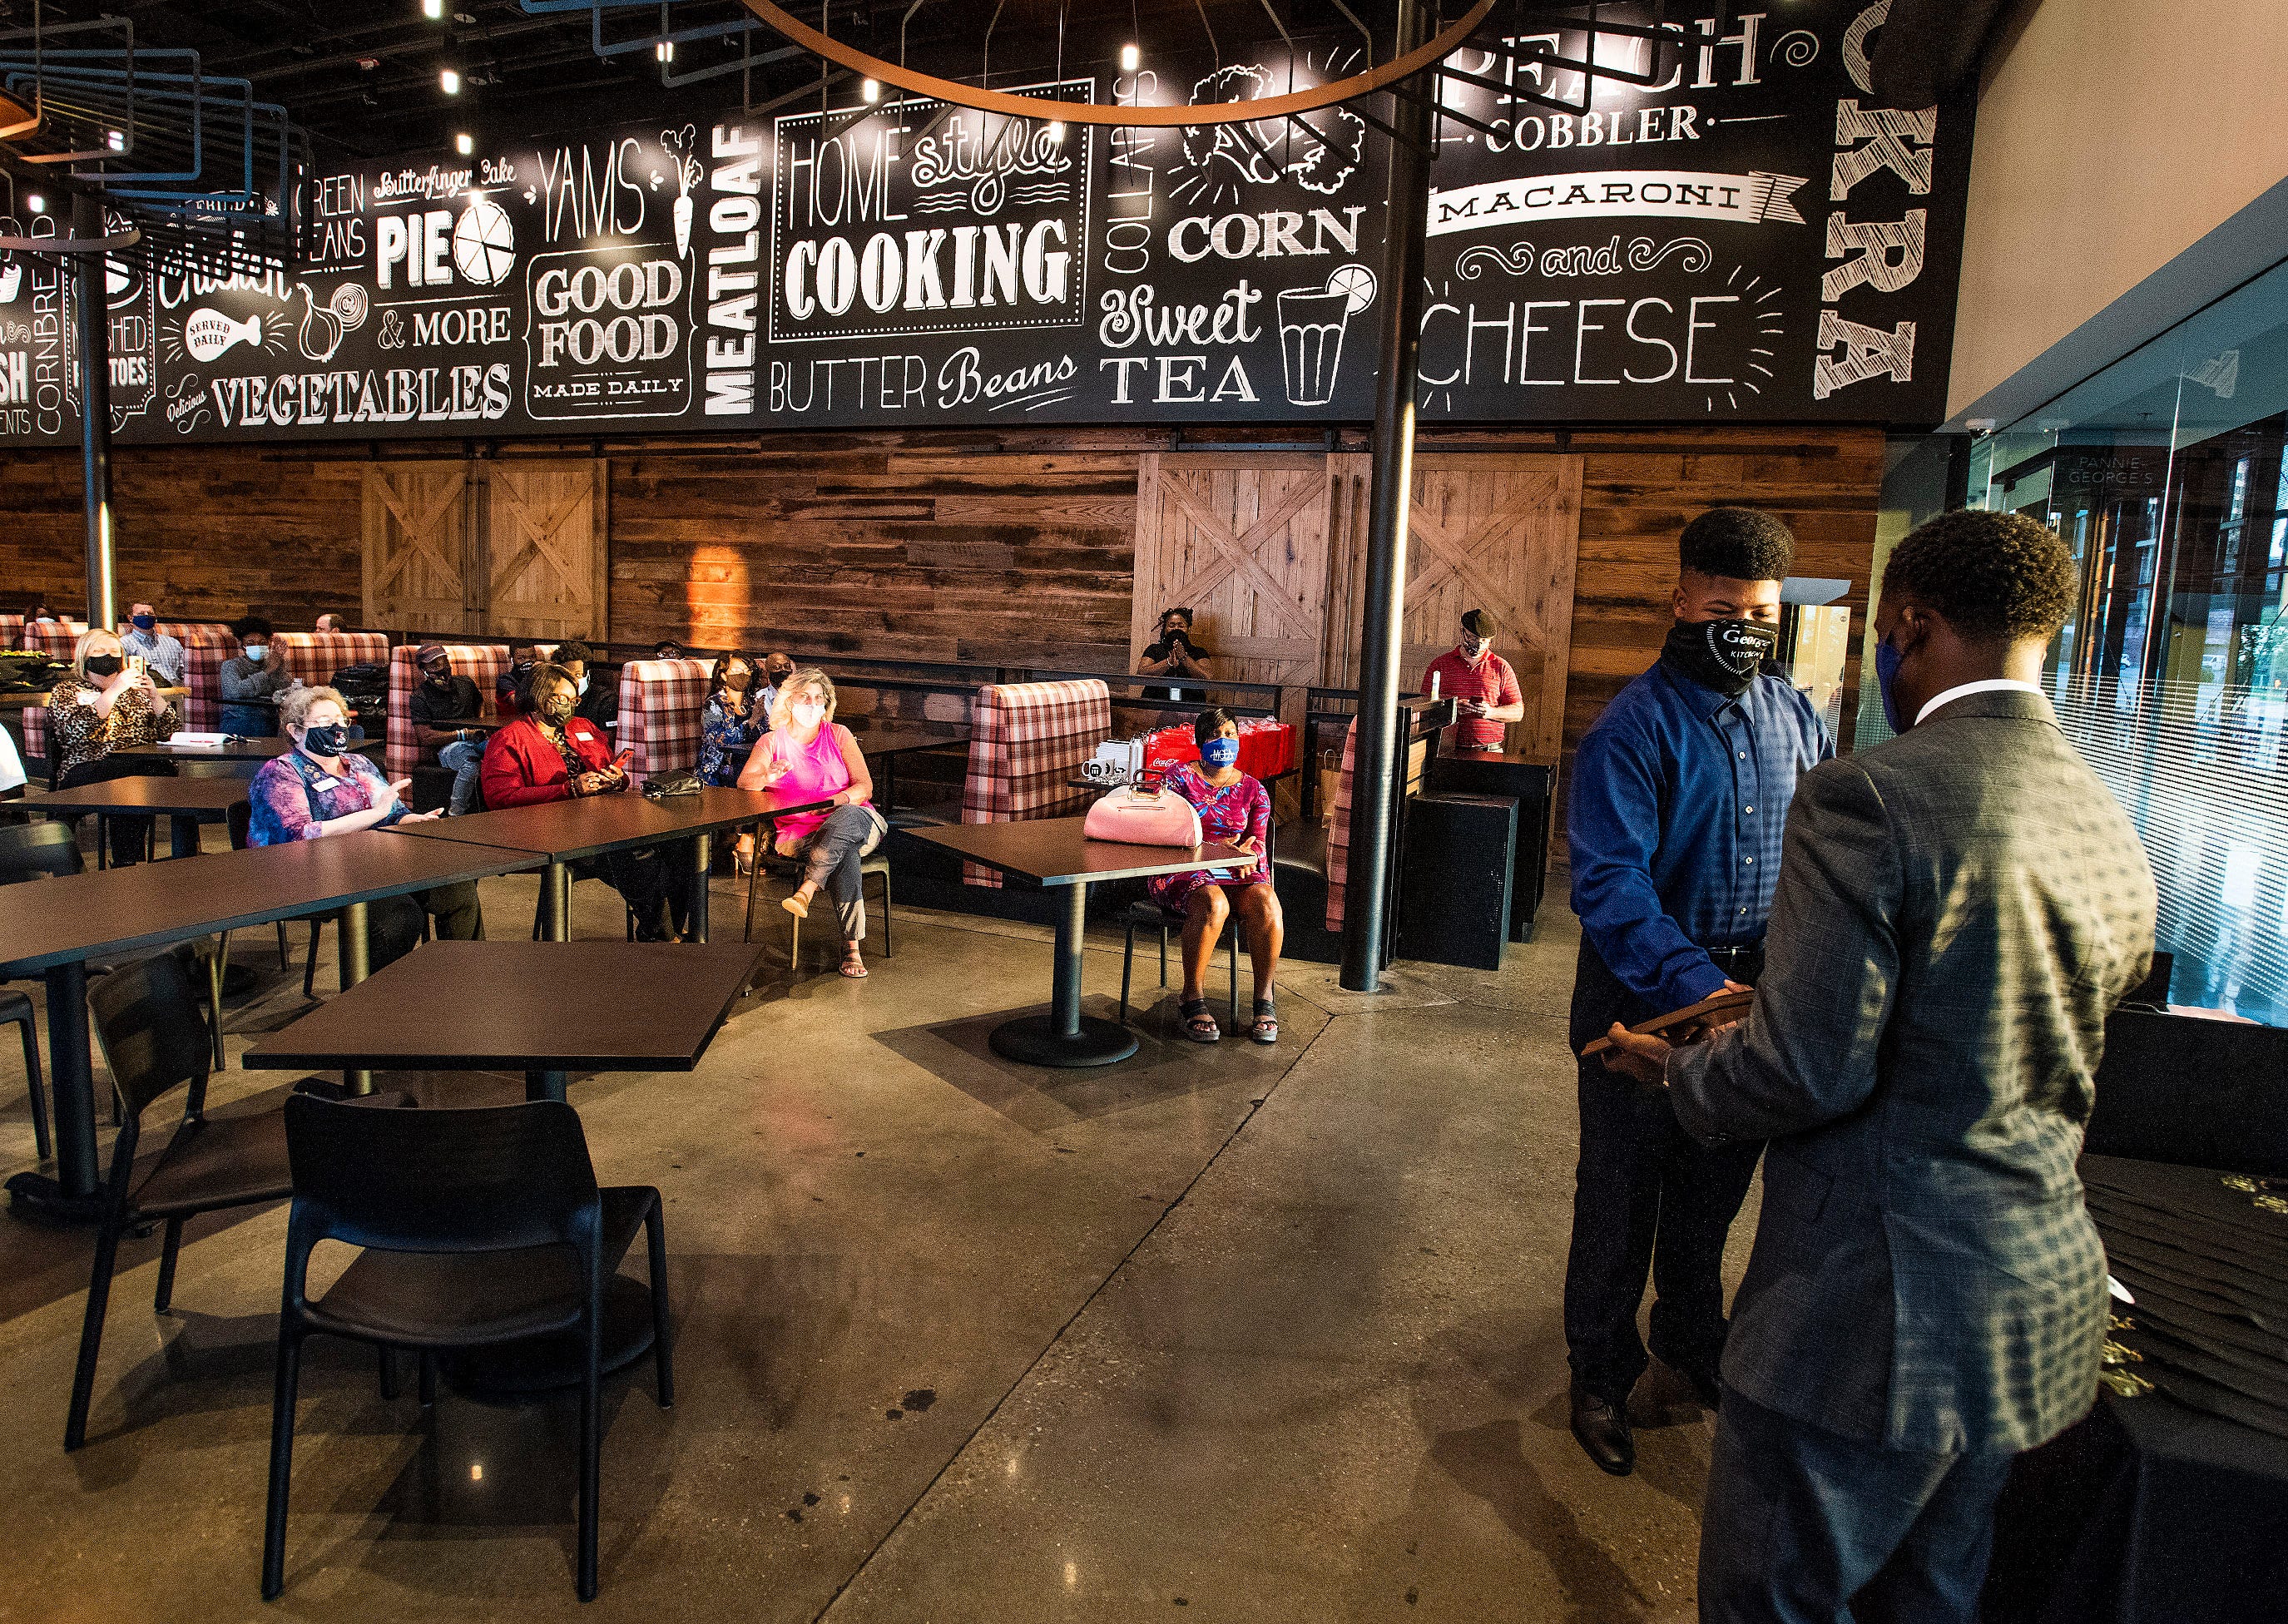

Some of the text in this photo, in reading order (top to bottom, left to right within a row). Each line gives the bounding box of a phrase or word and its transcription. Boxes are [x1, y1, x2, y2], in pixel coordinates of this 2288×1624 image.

[1440, 12, 1766, 108] PEACH
[1485, 104, 1701, 153] COBBLER
[374, 156, 518, 201] Butterfinger Cake
[537, 137, 645, 243] YAMS
[789, 115, 1072, 230] HOME style
[1438, 182, 1741, 224] MACARONI
[377, 210, 454, 290] PIE
[1167, 205, 1366, 264] CORN
[1540, 235, 1623, 278] and
[535, 258, 683, 317] GOOD
[705, 124, 762, 415] MEATLOAF
[784, 219, 1072, 320] COOKING
[31, 215, 62, 435] CORNBRED
[189, 319, 231, 336] SERVED
[193, 334, 227, 349] DAILY
[377, 307, 512, 350] & MORE
[537, 313, 680, 369] FOOD
[1098, 279, 1263, 349] Sweet
[1417, 296, 1741, 386] CHEESE
[166, 392, 208, 423] Delicious
[211, 364, 512, 428] VEGETABLES
[533, 379, 684, 399] MADE DAILY
[770, 346, 1079, 412] BUTTER Beans
[1099, 354, 1260, 404] TEA
